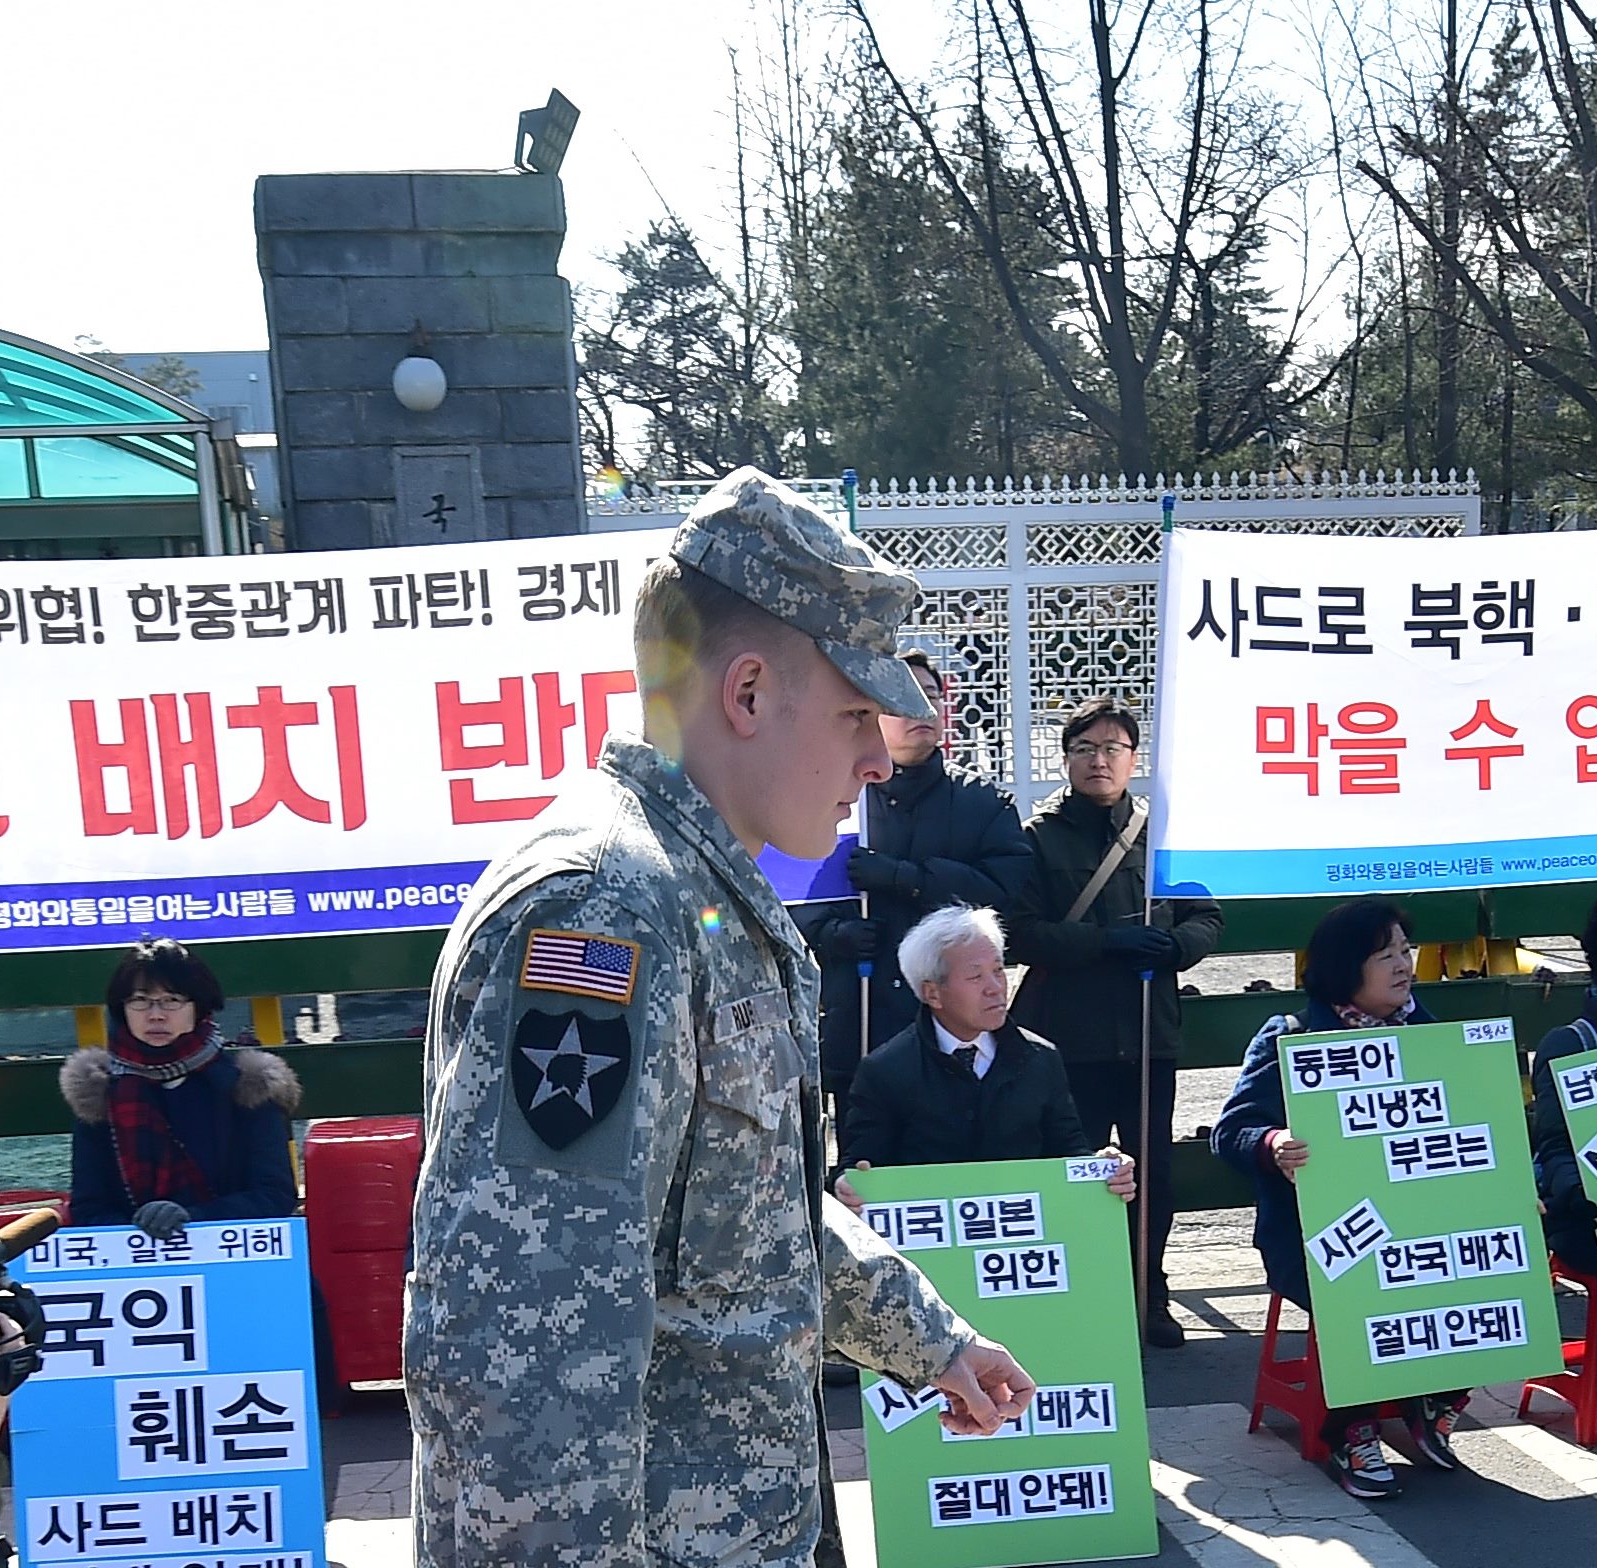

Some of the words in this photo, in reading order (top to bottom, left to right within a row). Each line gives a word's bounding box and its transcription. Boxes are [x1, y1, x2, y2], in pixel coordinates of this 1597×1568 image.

[422, 494, 456, 533] 국
[126, 577, 347, 642] 한중관계
[369, 568, 493, 630] 파탄!
[517, 559, 621, 622] 경제
[1187, 576, 1374, 658] 사드로
[69, 684, 369, 840] 배치
[1256, 701, 1407, 797] 막을
[1445, 699, 1525, 791] 수
[1326, 856, 1494, 883] 평화와통일을여는사람들
[1293, 1042, 1395, 1088] 동북아
[1345, 1086, 1444, 1132] 신냉전
[1389, 1132, 1489, 1175] 부르는
[867, 1204, 944, 1246] 미국
[959, 1198, 1036, 1241] 일본
[1319, 1206, 1385, 1269] 사드
[1380, 1240, 1449, 1284] 한국
[1457, 1231, 1524, 1272] 배치
[32, 1236, 109, 1268] 미국,
[128, 1233, 193, 1264] 일본
[219, 1227, 283, 1259] 위해
[982, 1249, 1060, 1292] 위한
[36, 1284, 195, 1367] 국익
[1371, 1314, 1440, 1358] 절대
[1444, 1306, 1522, 1348] 안돼!
[129, 1382, 294, 1465] 훼손
[1037, 1388, 1112, 1429] 배치
[934, 1478, 1011, 1521] 절대
[1019, 1472, 1108, 1514] 안돼!
[38, 1501, 148, 1553] 사드
[172, 1492, 273, 1546] 배치
